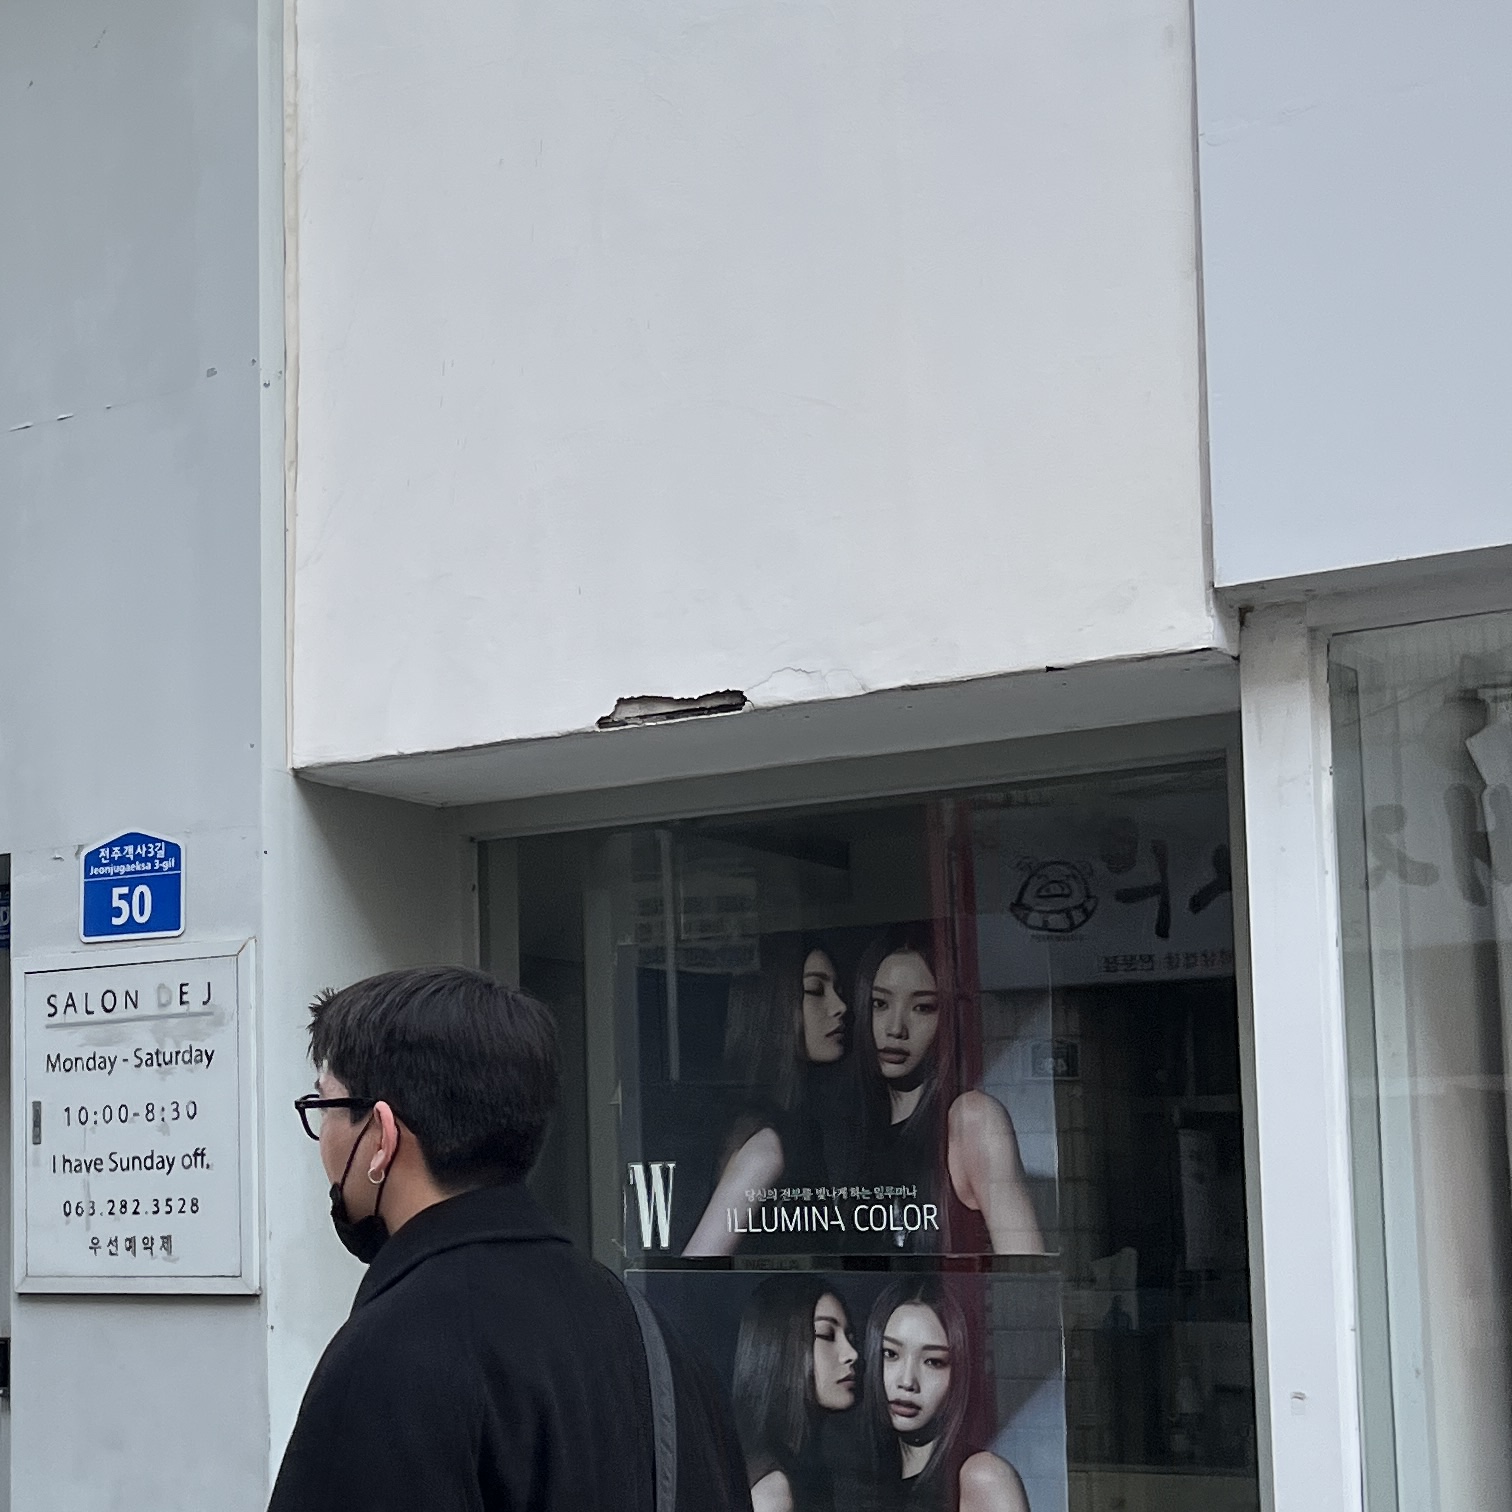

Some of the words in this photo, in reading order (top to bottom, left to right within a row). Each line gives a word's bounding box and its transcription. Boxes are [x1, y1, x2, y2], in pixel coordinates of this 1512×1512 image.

[99, 841, 165, 864] 전주객사3길
[89, 860, 151, 876] Jeonjugaeksa
[111, 884, 152, 926] 50
[46, 988, 139, 1018] SALON
[45, 1051, 117, 1075] Monday
[134, 1044, 215, 1069] Saturday
[64, 1100, 197, 1127] 10:00-8:30
[62, 1153, 104, 1173] have
[108, 1149, 175, 1176] Sunday
[181, 1147, 210, 1170] off.
[63, 1197, 200, 1217] 063.282.3528
[629, 1161, 676, 1250] W
[745, 1187, 778, 1202] 당신의
[727, 1205, 846, 1233] ILLUMINA
[854, 1203, 940, 1232] COLOR
